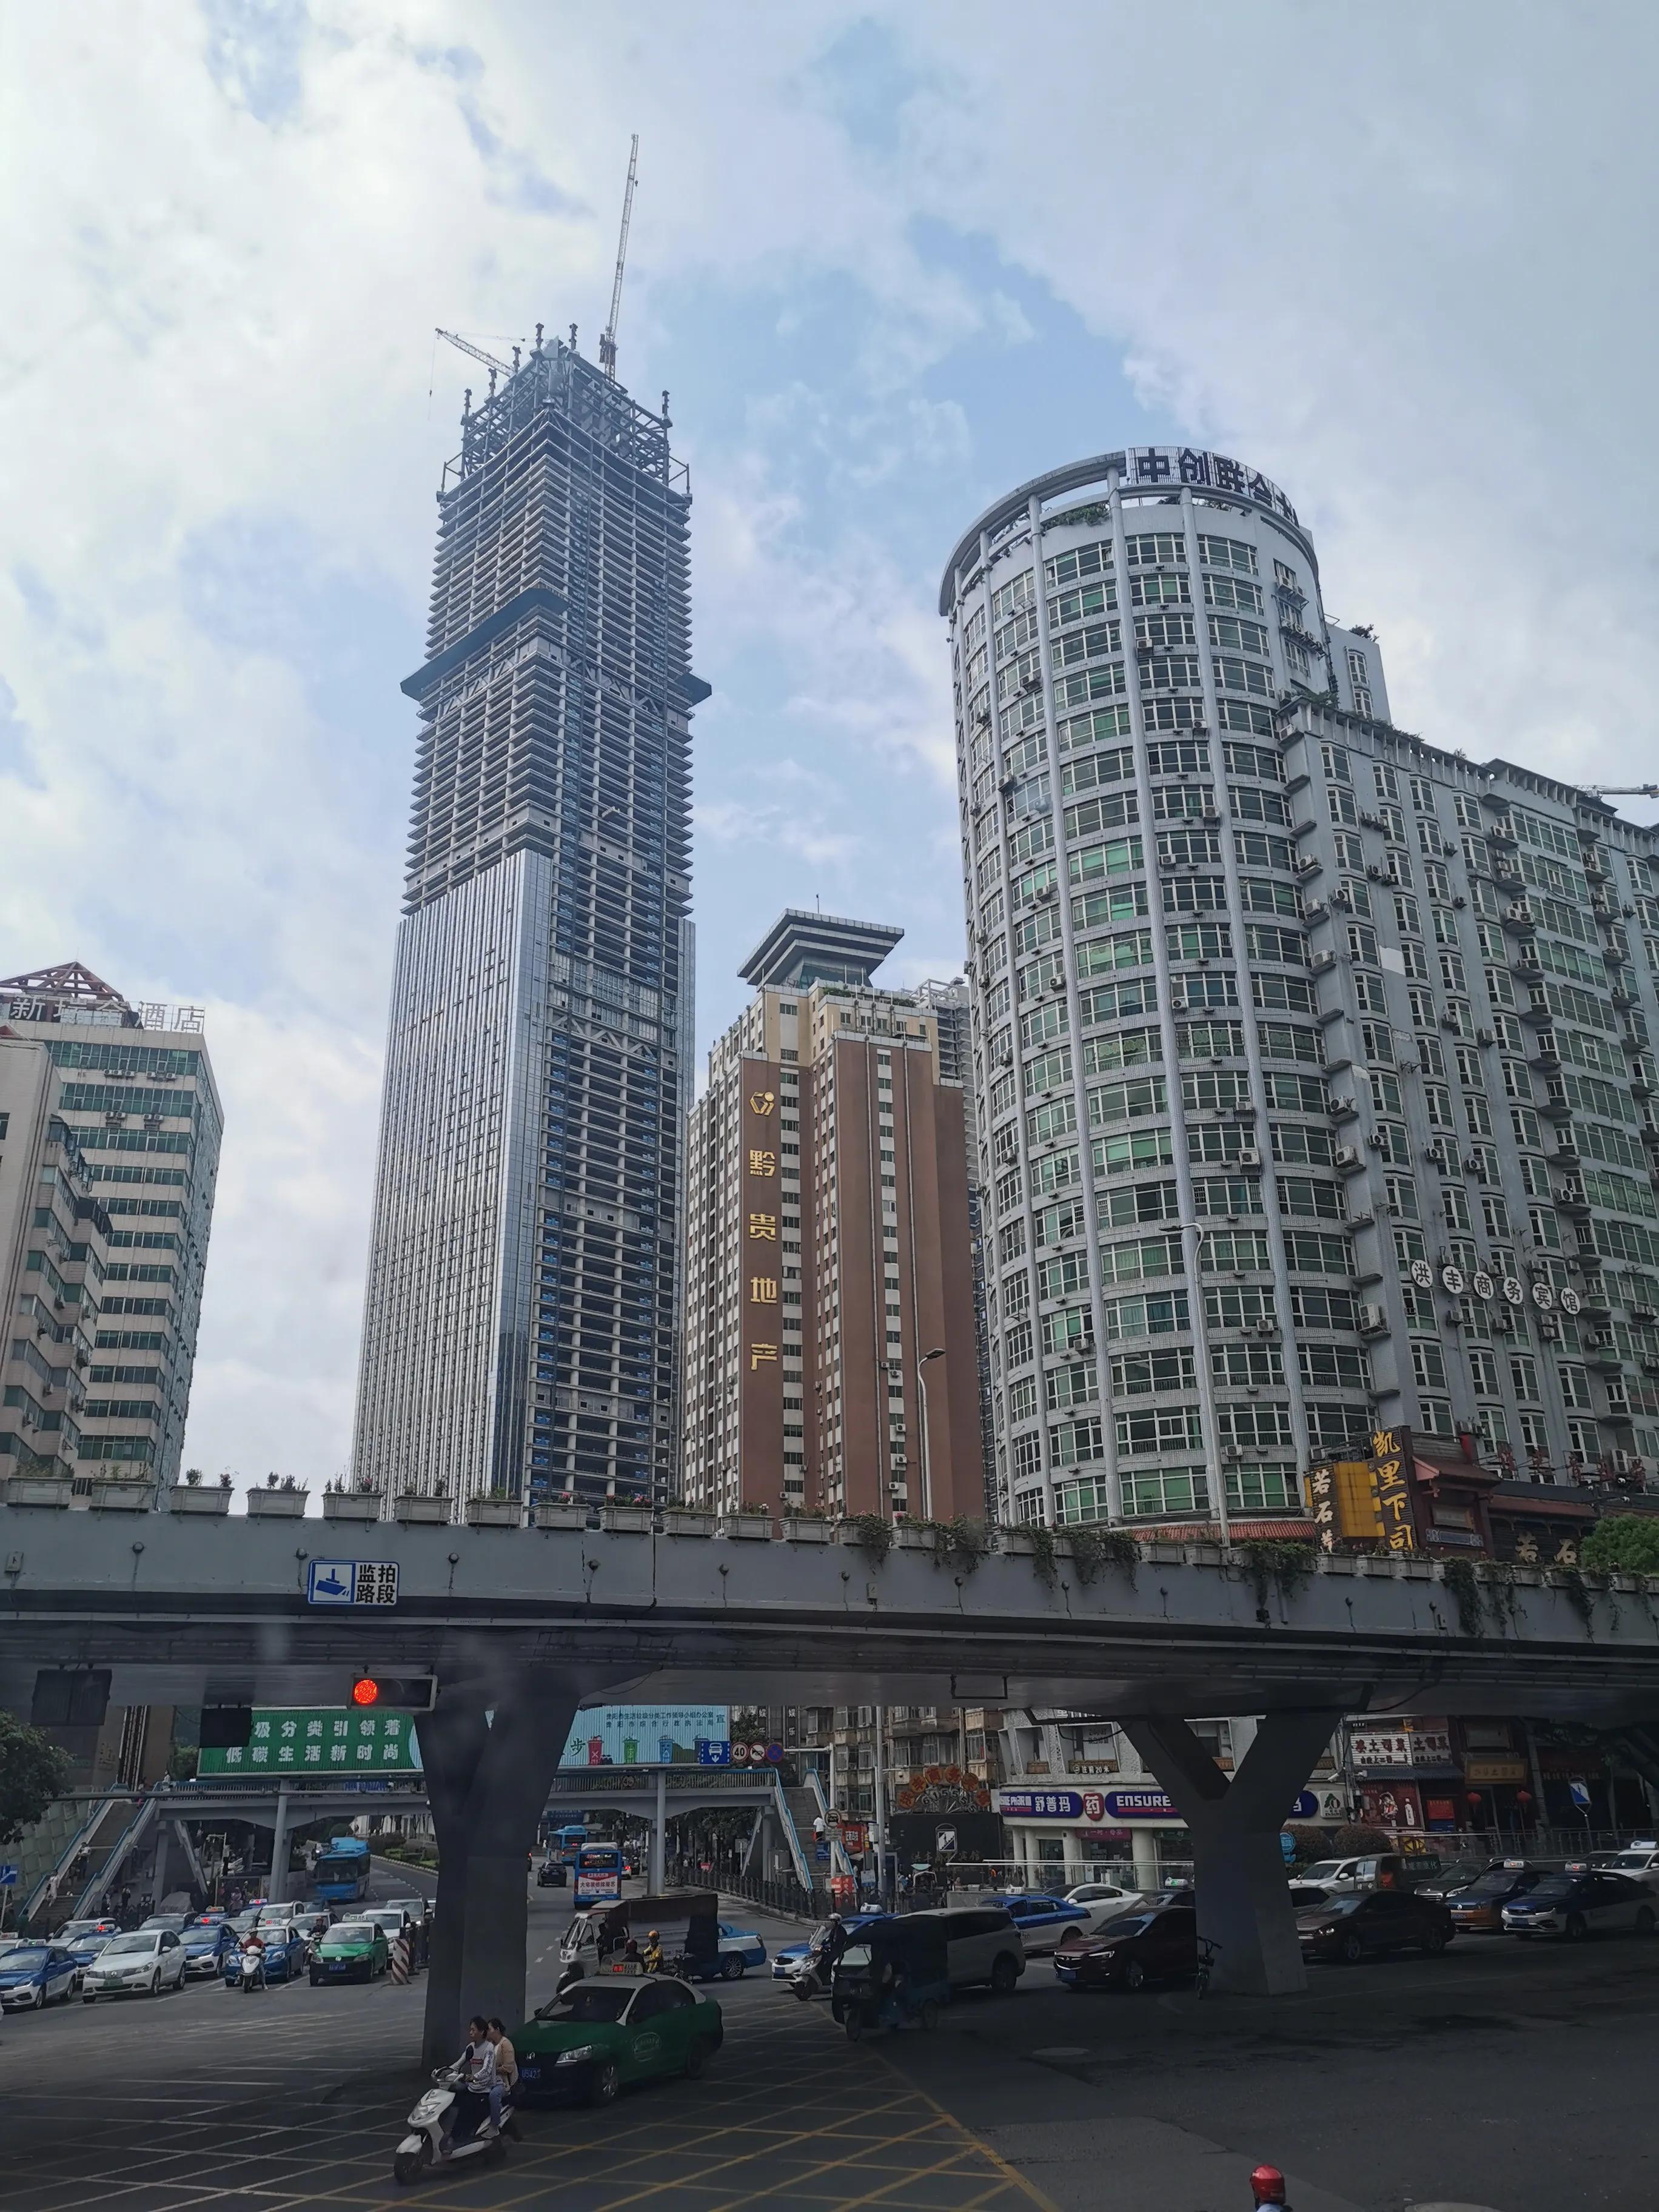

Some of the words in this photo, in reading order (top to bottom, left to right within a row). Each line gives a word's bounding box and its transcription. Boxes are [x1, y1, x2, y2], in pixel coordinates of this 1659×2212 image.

[10, 996, 204, 1033] 新瑞金酒店
[749, 1149, 777, 1370] 黔贵地产
[1414, 1261, 1578, 1312] 洪丰商务宾馆
[1373, 1431, 1413, 1550] 凯里下司
[357, 1564, 396, 1583] 监拍
[356, 1584, 395, 1603] 路段
[226, 1744, 399, 1763] 低碳生活新时尚
[734, 1748, 745, 1757] 40
[1035, 1795, 1071, 1812] 舒普玛
[1085, 1795, 1101, 1815] 药
